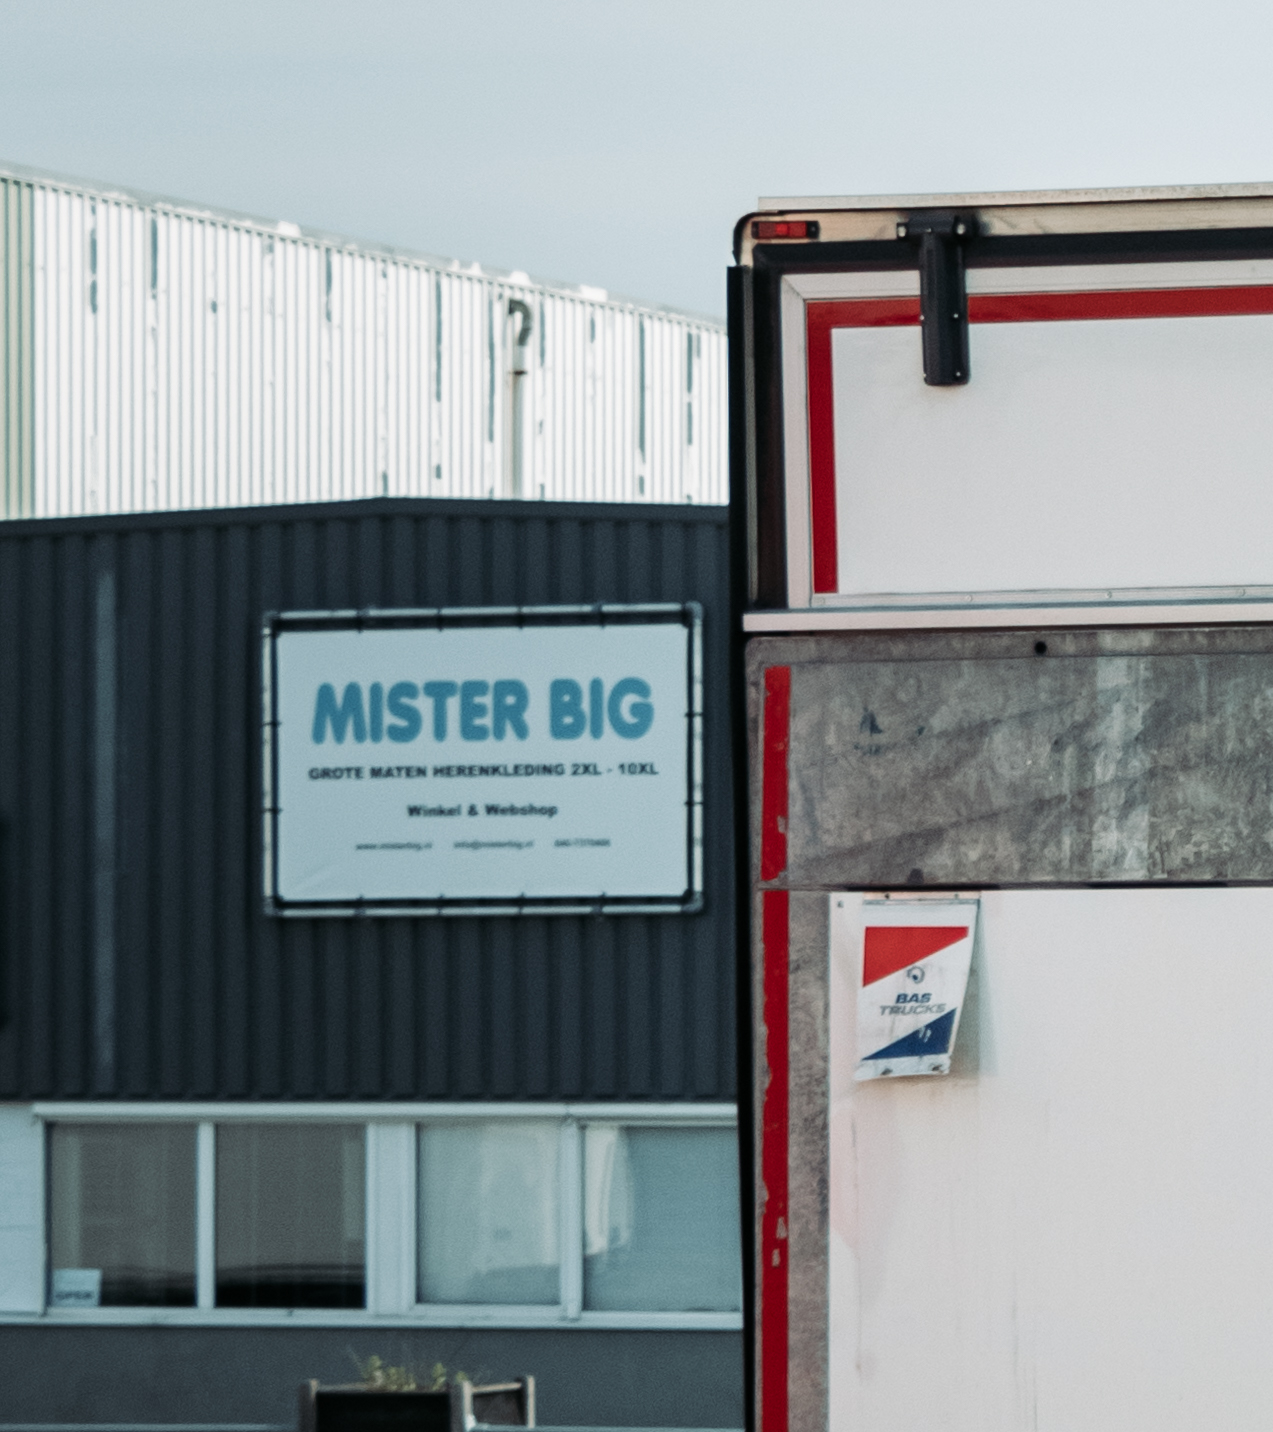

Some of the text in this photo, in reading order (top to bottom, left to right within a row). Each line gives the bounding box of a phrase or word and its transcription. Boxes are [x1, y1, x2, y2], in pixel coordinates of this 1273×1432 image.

[311, 677, 654, 744] MISTER BIG
[308, 767, 363, 780] GROTE
[370, 765, 427, 779] MATEN
[433, 763, 565, 778] HERENKLEDING
[571, 762, 602, 776] 2XL
[407, 803, 558, 819] Winkel & Webshop
[895, 992, 932, 1005] BAS
[880, 1003, 946, 1016] TRUCKS
